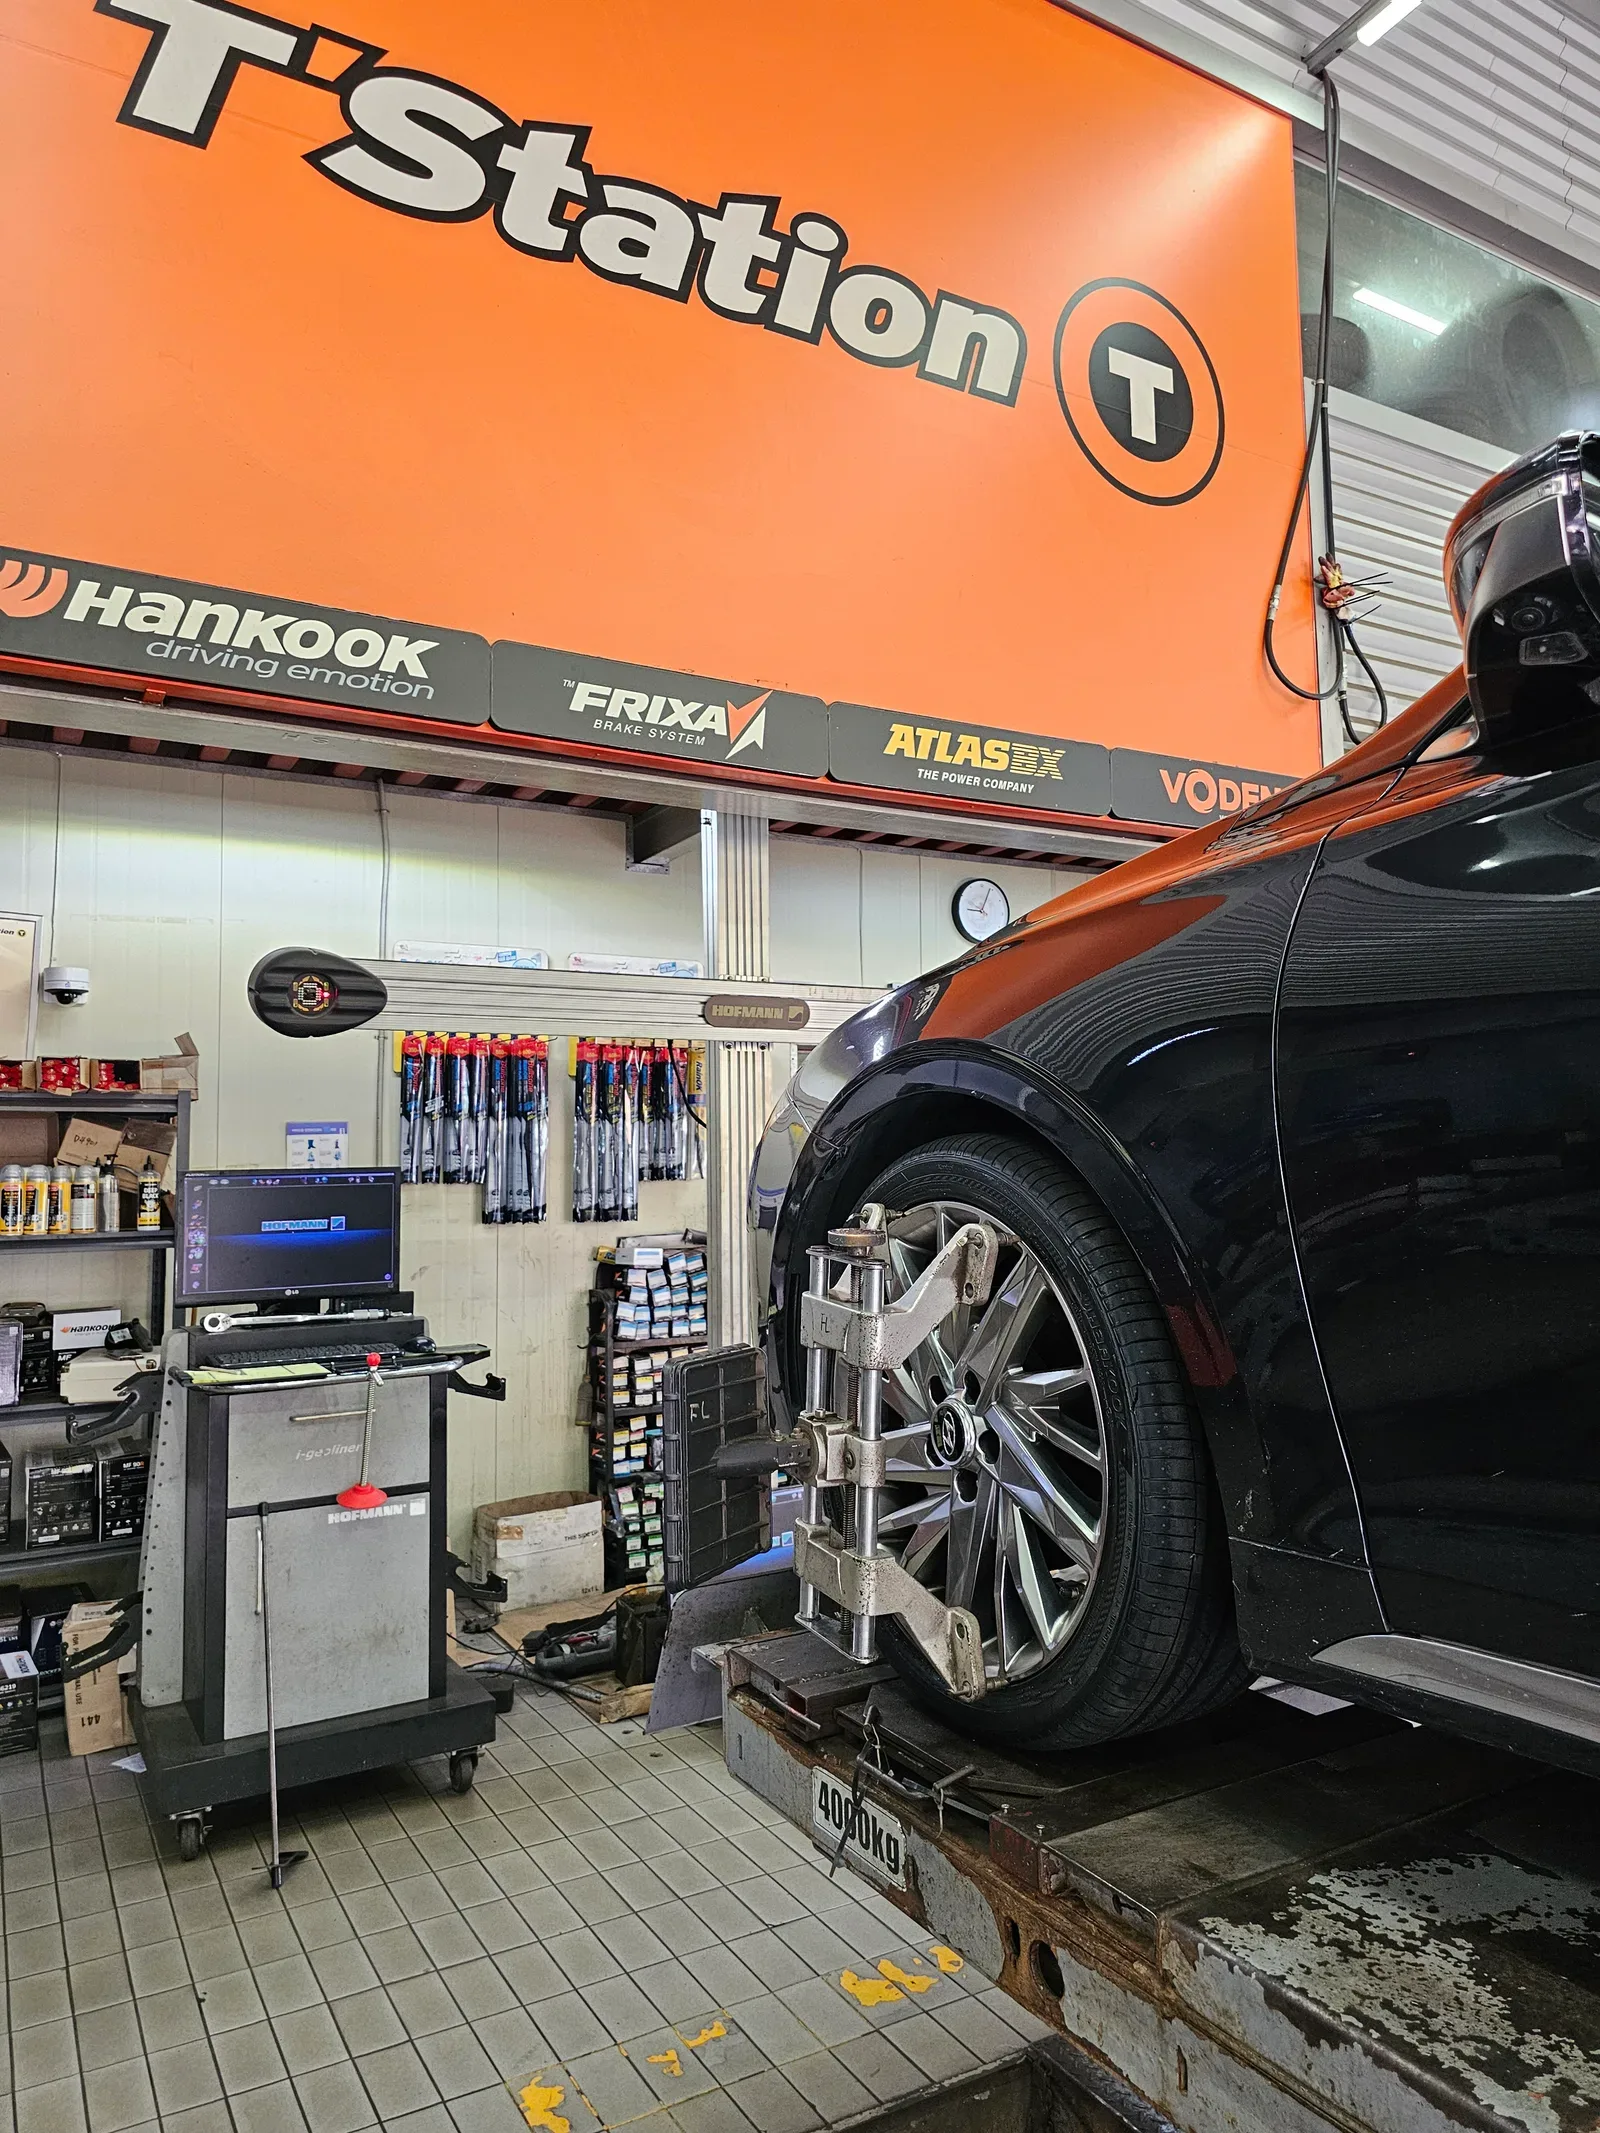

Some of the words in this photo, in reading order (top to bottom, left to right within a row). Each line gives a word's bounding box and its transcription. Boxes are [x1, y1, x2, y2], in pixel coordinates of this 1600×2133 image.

[95, 0, 1026, 406] T'Station
[1108, 346, 1174, 445] T
[146, 639, 280, 678] driving
[287, 663, 435, 700] emotion
[562, 679, 576, 689] TM
[569, 682, 728, 736] FRIXA
[593, 719, 644, 737] BRAKE
[648, 728, 706, 746] SYSTEM
[917, 768, 940, 781] THE
[941, 772, 980, 788] POWER
[983, 778, 1035, 794] COMPANY
[1159, 768, 1282, 814] VODE
[711, 1004, 784, 1019] HOFMANN
[261, 1219, 329, 1232] HOFMANN
[689, 1401, 710, 1422] FL
[328, 1504, 404, 1524] HOFMANN
[81, 1713, 101, 1728] 441
[818, 1780, 900, 1875] 4000kg
